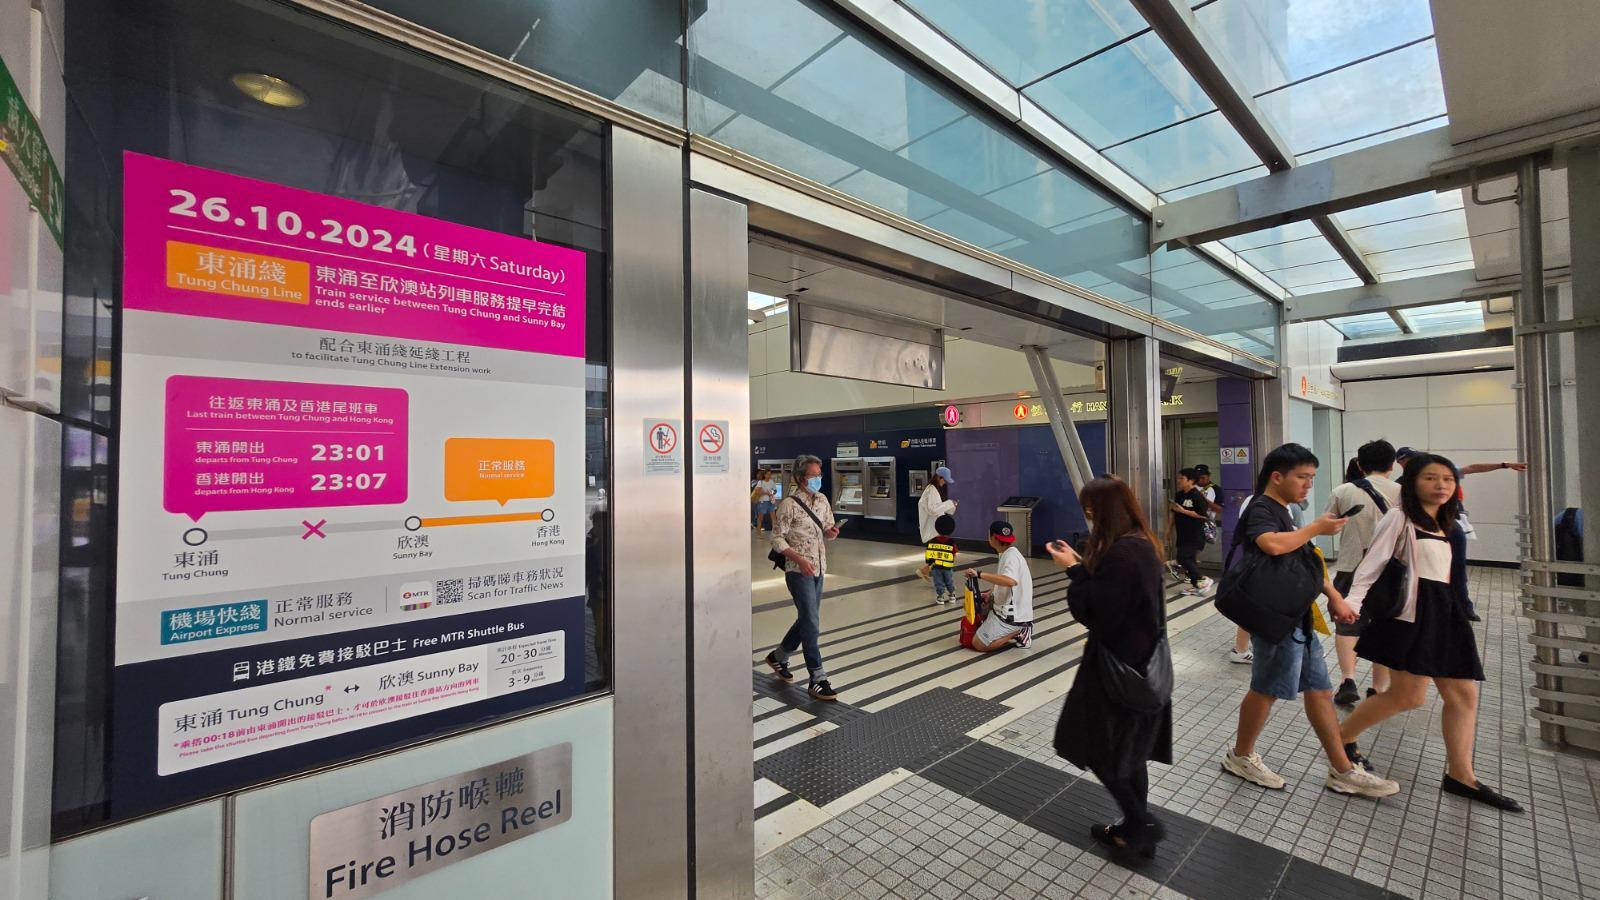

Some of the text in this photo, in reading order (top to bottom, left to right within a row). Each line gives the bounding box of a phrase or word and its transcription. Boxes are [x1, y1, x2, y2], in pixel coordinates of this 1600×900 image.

[168, 189, 417, 257] 26.10.2024
[489, 256, 566, 284] Saturday)
[195, 251, 288, 285] 東涌綫
[176, 272, 303, 300] Tung Chung Line
[315, 265, 566, 318] 東涌至欣澳站列車服務提早完結
[315, 299, 387, 315] ends earlier
[315, 285, 566, 330] Train service between Tung Chung and Sunny Bay
[319, 337, 471, 364] 配合東涌綫延綫工程
[291, 351, 492, 375] to facilitate Tung Chung Line Extension work
[208, 395, 378, 415] 往返東涌及香港尾班車
[186, 410, 394, 425] Last train between Tung Chung and Hong Kong
[196, 440, 265, 454] 東涌開出
[311, 443, 385, 462] 23:01
[195, 456, 298, 465] departs from Tung Chung
[479, 460, 526, 471] 正常服務
[195, 472, 264, 486] 香港開出
[311, 472, 388, 491] 23:07
[194, 486, 295, 496] departs from Hong Kong
[536, 524, 561, 539] 香港
[397, 534, 430, 550] 欣澳
[531, 538, 565, 548] Hong Kong
[174, 550, 219, 568] 東涌
[392, 550, 433, 560] Sunny Bay
[162, 568, 229, 581] Tung Chung
[467, 580, 564, 600] Scan for Traffic News
[274, 591, 353, 614] 正常服務
[168, 604, 262, 631] 機場快綫
[274, 606, 373, 628] Normal service
[170, 622, 260, 642] Airport Express
[256, 621, 525, 677] 港鐵免費接駁巴士 Free MTR Shuttle Bus
[378, 661, 480, 691] 欣澳 Sunny Bay
[174, 708, 222, 733] 東涌
[226, 705, 269, 721] Tung
[379, 766, 525, 840] 消防喉轆
[326, 788, 561, 899] Fire Hose Reel
